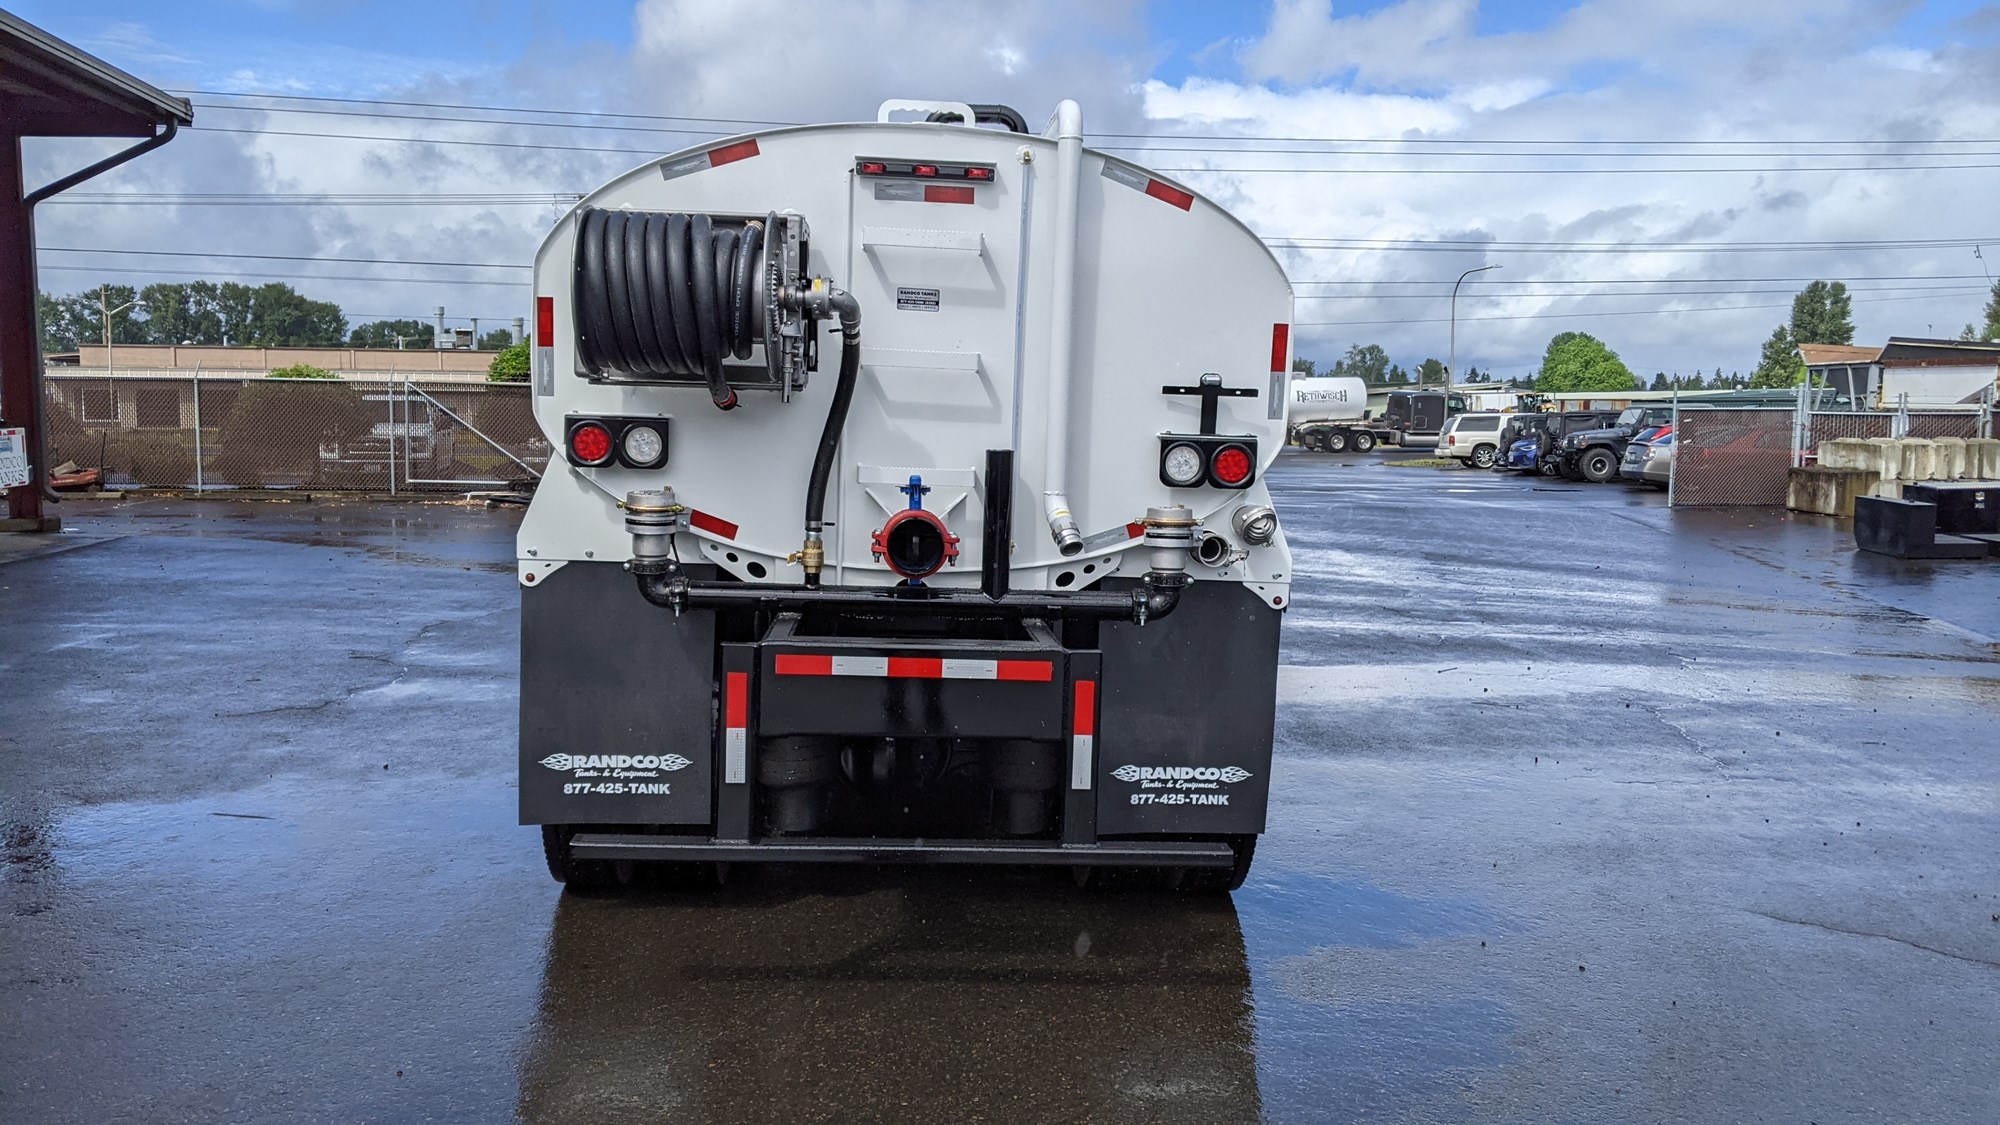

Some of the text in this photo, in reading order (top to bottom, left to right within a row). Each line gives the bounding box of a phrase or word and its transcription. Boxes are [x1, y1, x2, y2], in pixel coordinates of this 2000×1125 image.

[573, 754, 660, 769] RANDCO
[573, 768, 659, 779] Tanks & Equipment
[1140, 766, 1221, 781] RANDCO
[563, 783, 670, 794] 877-425-TANK
[1140, 779, 1219, 790] Tanks & Equipment
[1130, 794, 1229, 805] 877-425-TANK
